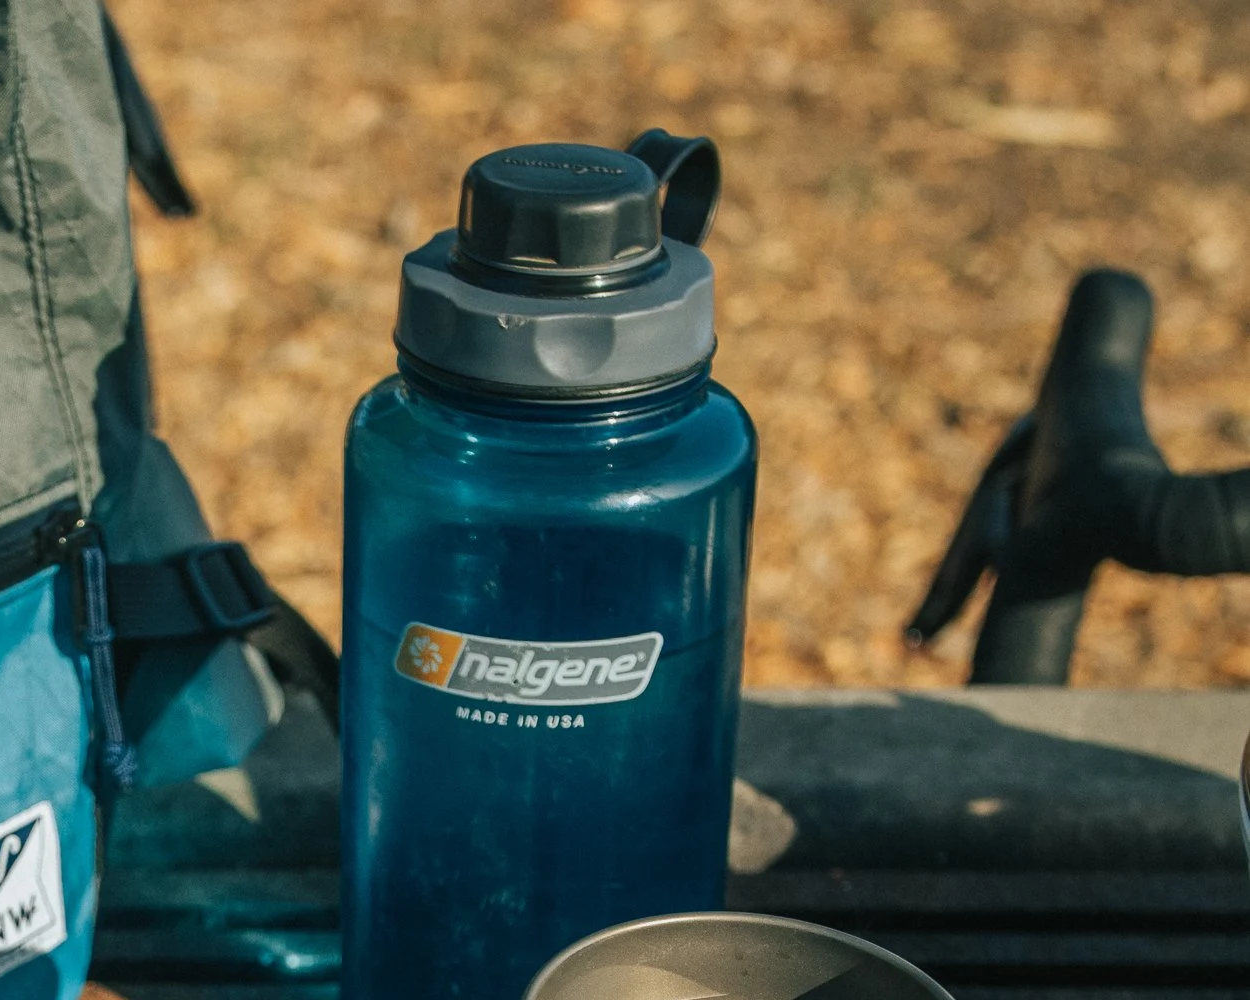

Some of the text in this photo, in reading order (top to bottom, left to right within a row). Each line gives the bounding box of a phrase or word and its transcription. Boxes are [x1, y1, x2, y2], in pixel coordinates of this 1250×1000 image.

[457, 649, 646, 697] nalgene
[455, 705, 586, 729] MADE IN USA
